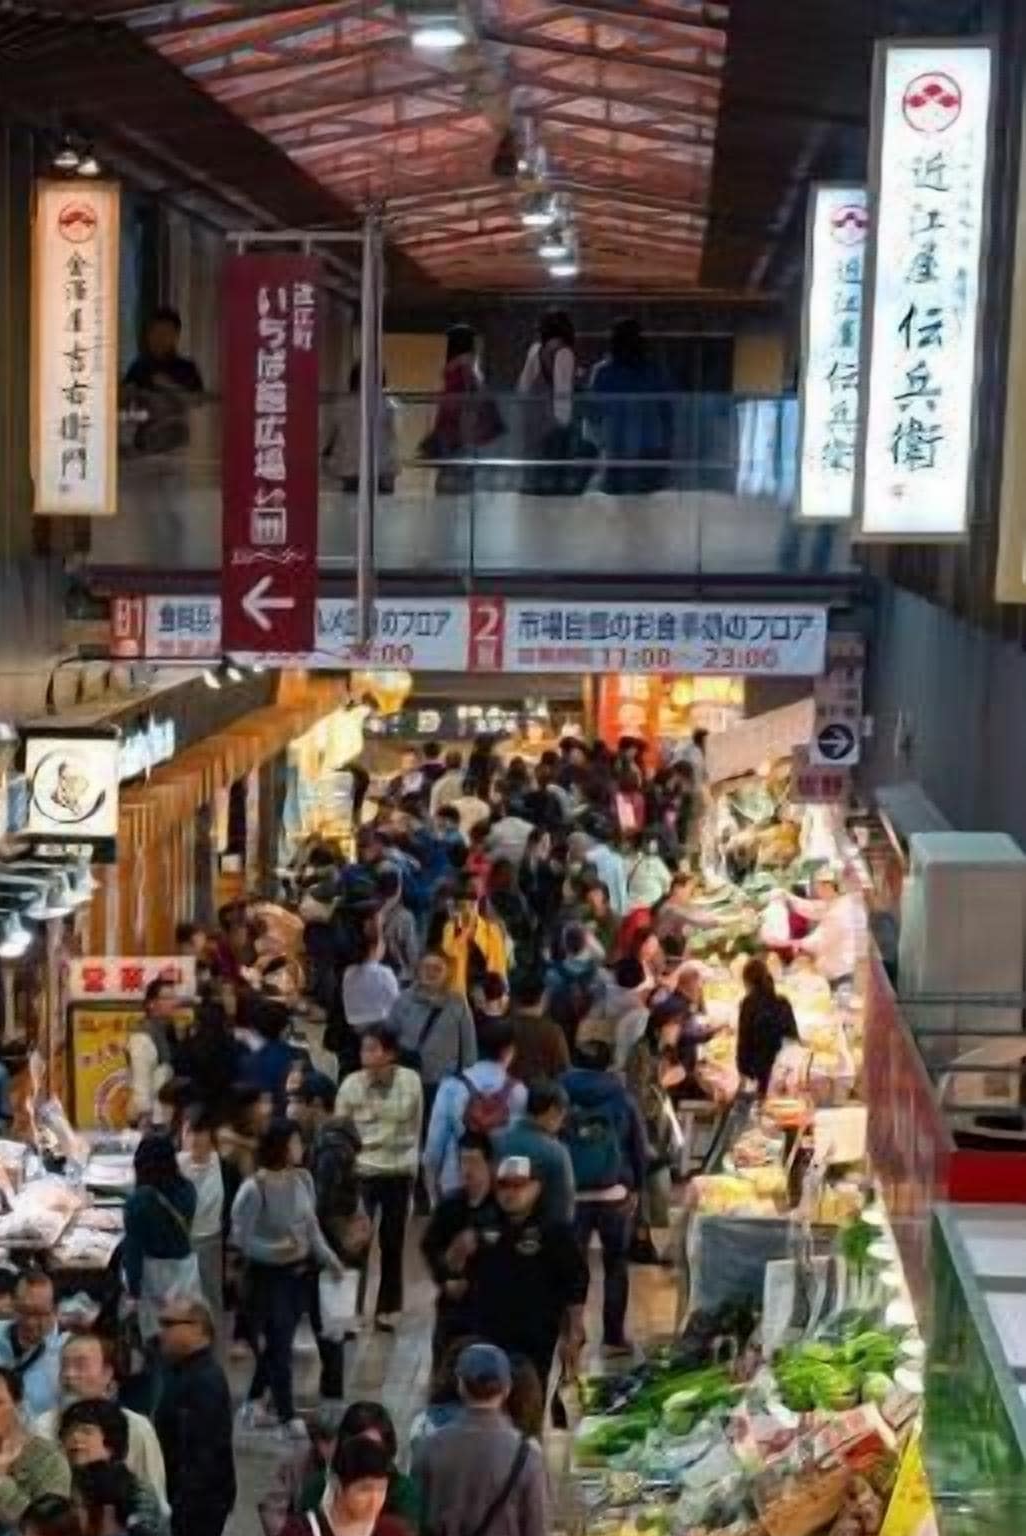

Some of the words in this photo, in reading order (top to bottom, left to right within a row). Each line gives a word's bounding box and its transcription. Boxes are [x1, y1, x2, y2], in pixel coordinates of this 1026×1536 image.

[889, 150, 950, 472] 近江屋伝兵衛
